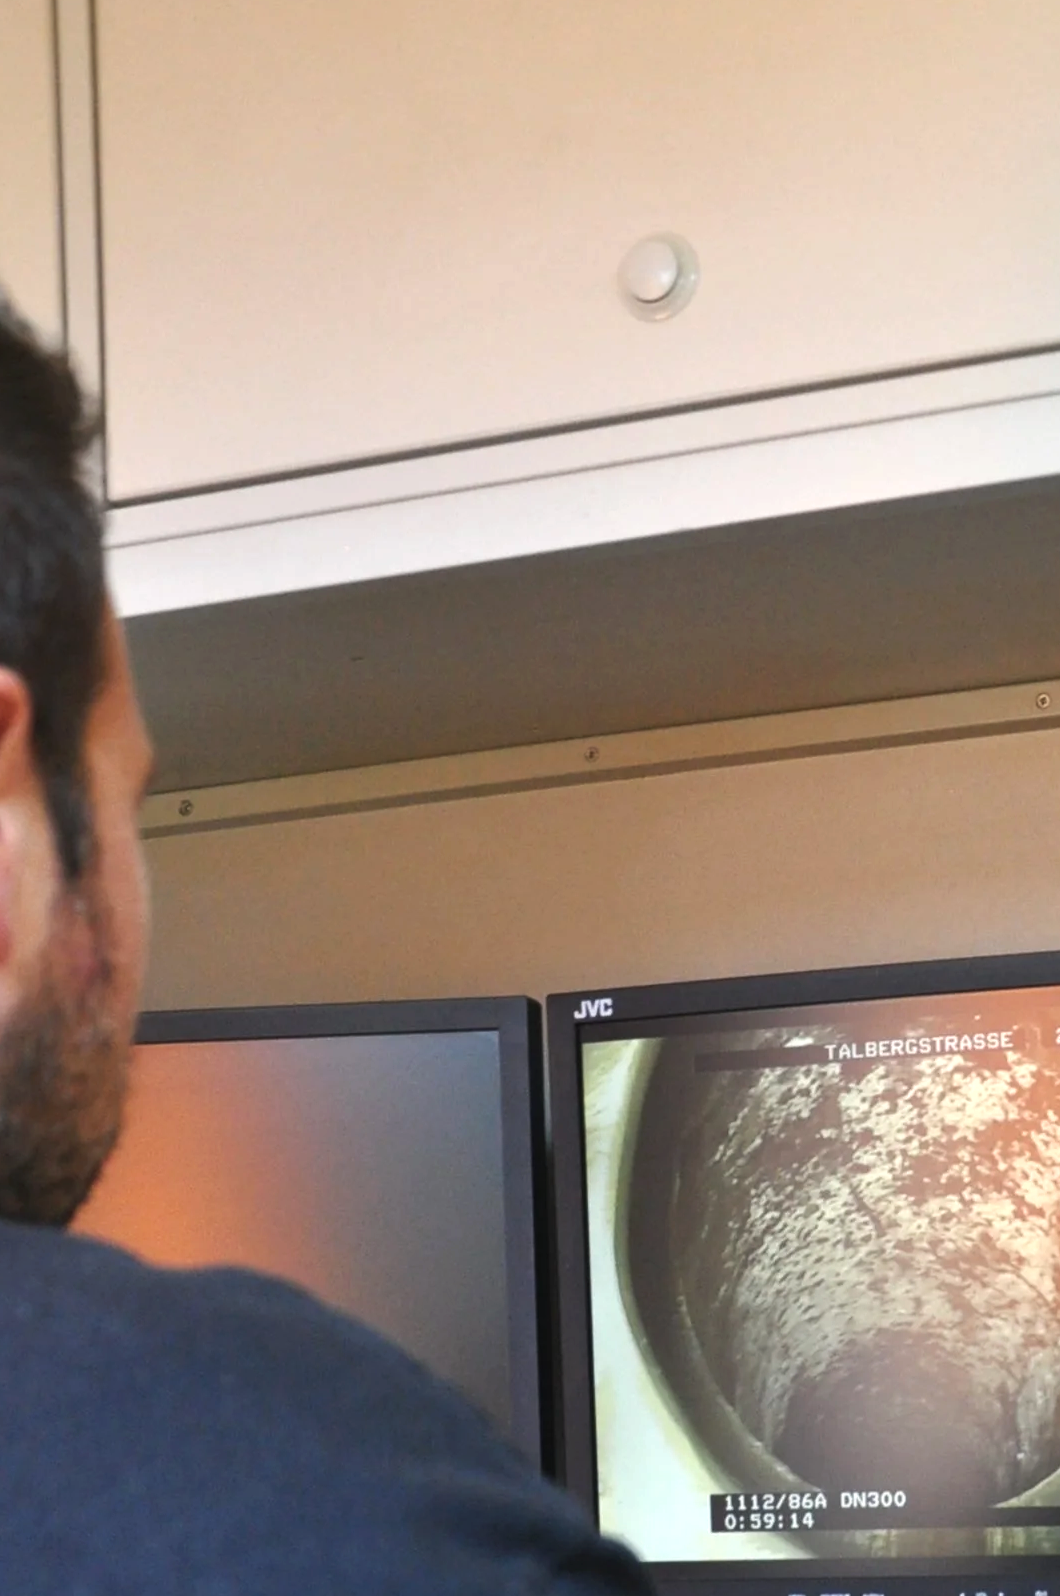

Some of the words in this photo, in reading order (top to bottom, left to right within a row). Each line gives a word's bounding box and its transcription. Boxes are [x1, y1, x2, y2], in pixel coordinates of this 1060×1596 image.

[573, 998, 613, 1019] JVC
[824, 1031, 1014, 1060] TALBERGSTRASSE
[725, 1493, 827, 1511] 1112/86A
[840, 1491, 907, 1508] DN300
[725, 1512, 814, 1530] 0:59:14
